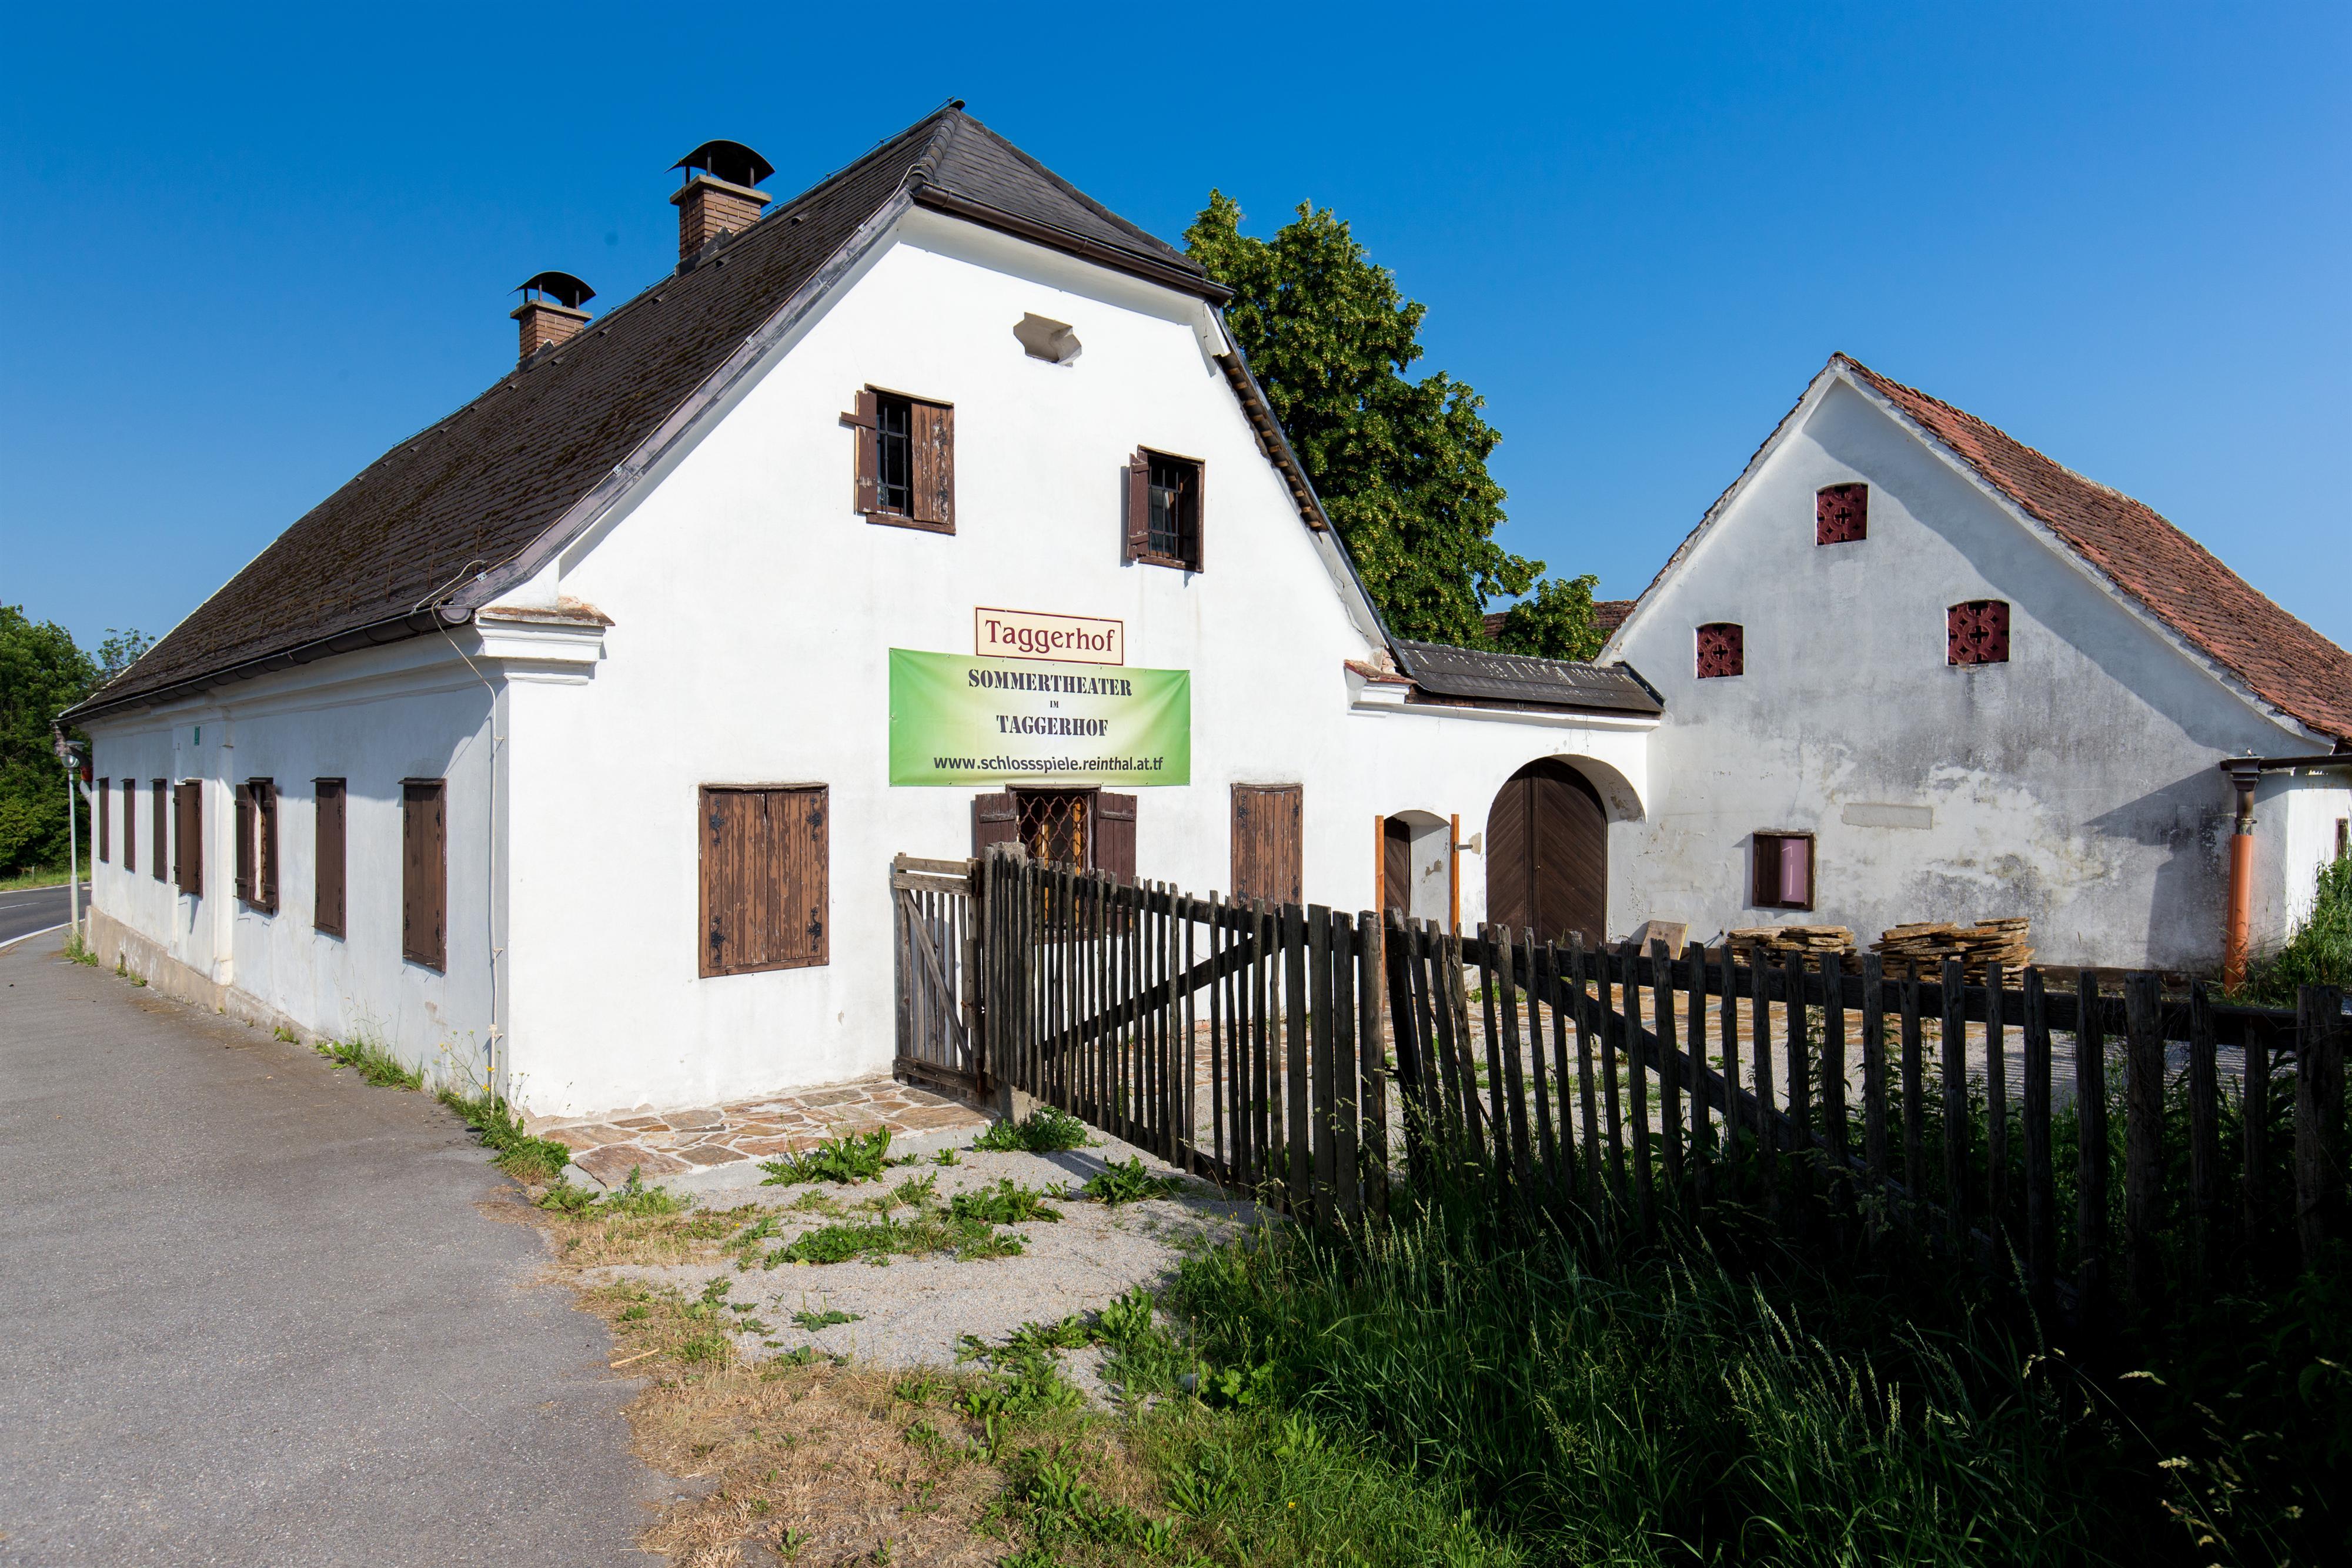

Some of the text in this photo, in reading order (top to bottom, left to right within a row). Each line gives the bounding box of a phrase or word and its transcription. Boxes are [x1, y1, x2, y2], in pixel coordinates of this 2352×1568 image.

[985, 620, 1115, 654] Taggerhof
[968, 668, 1132, 696] SOMMERTHEATER
[1050, 700, 1059, 708] IM
[996, 715, 1108, 736] TAGGERHOF
[933, 755, 1164, 774] www.schlossspiele.reinthal.at.tf
